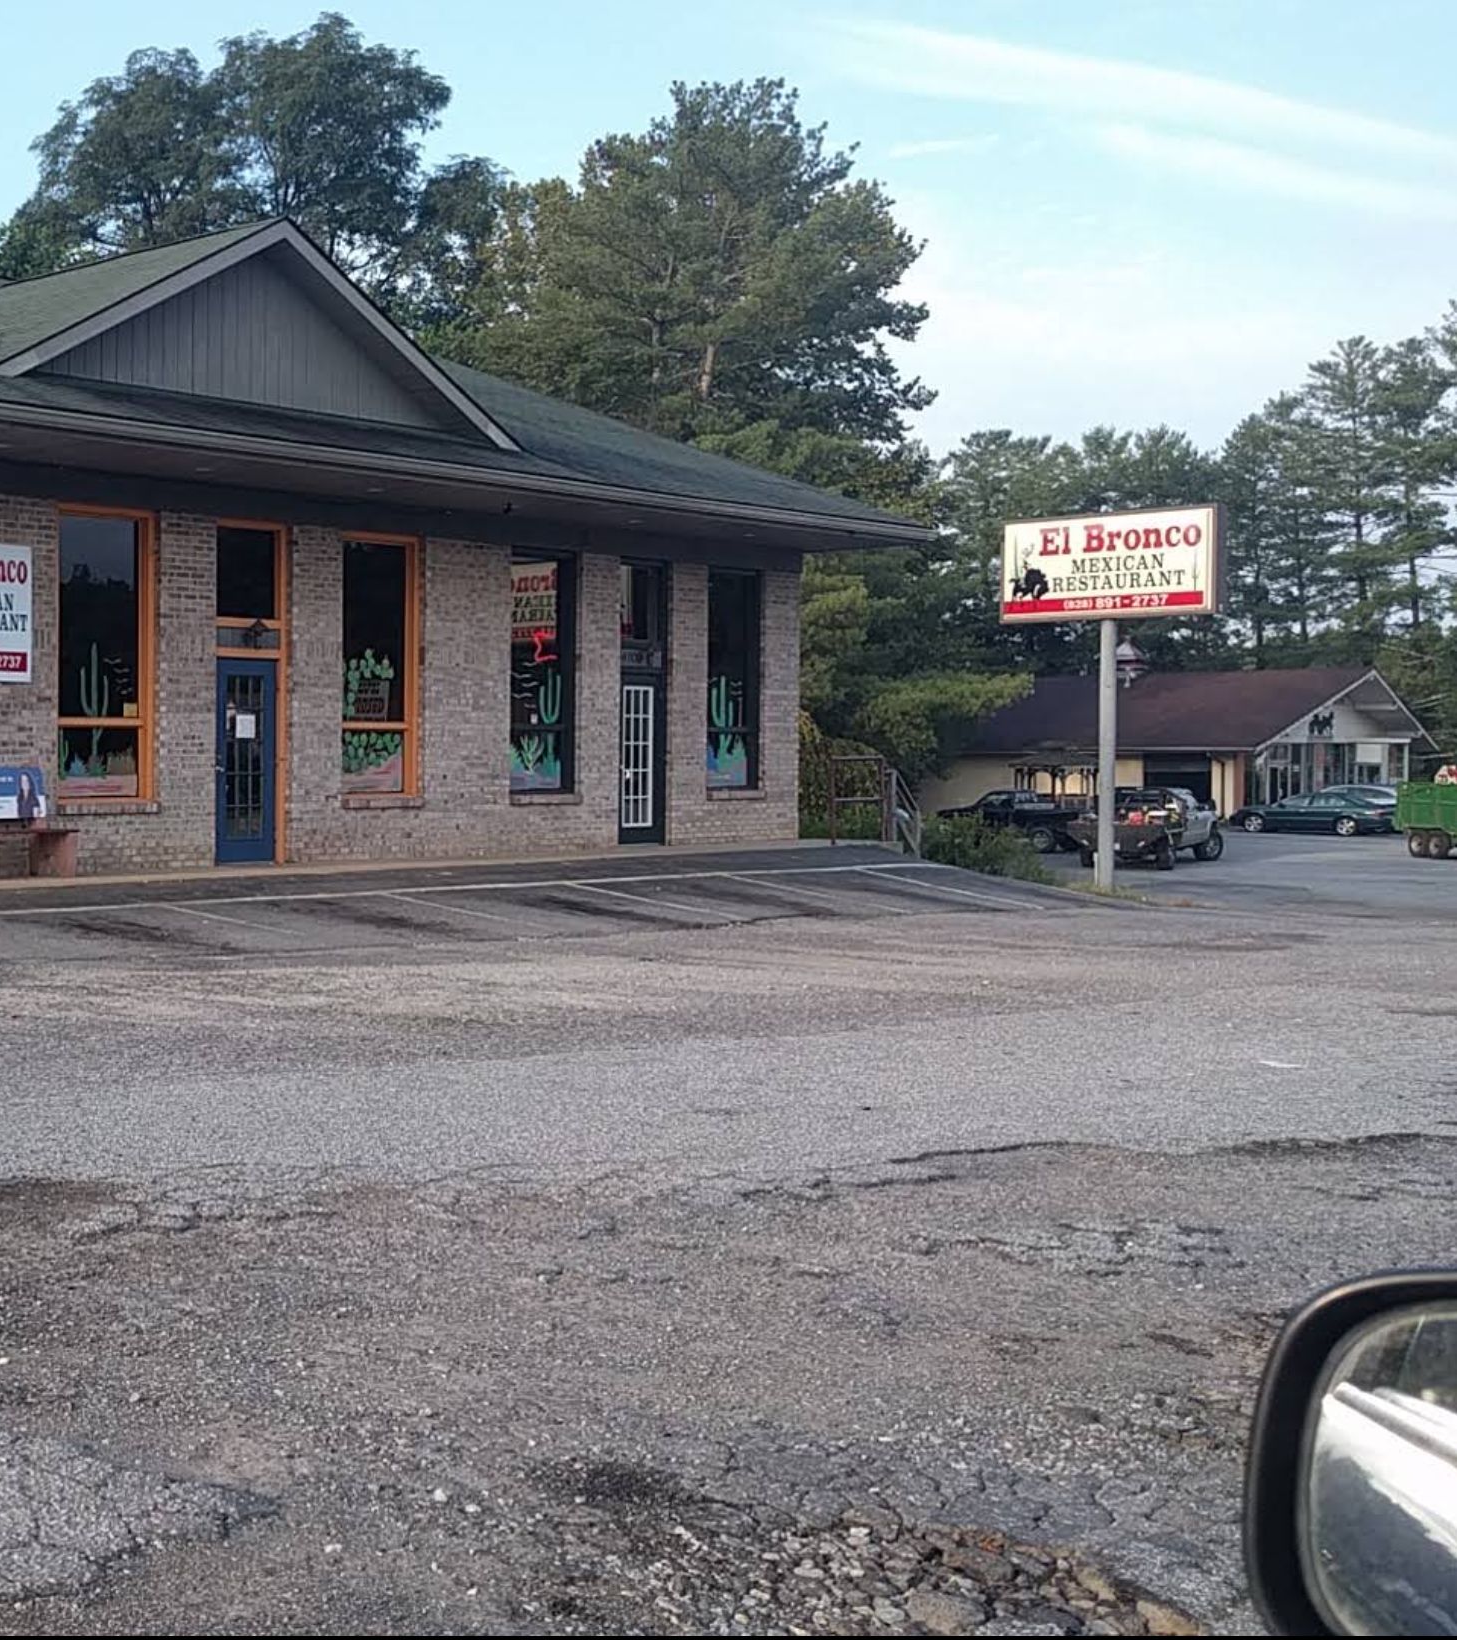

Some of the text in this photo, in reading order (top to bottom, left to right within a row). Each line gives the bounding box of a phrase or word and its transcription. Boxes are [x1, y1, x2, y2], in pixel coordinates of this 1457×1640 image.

[1039, 524, 1202, 556] El Bronco
[1071, 553, 1165, 575] MEXICAN
[1052, 569, 1186, 593] RESTAURANT
[1064, 594, 1169, 609] (828) 891-2737
